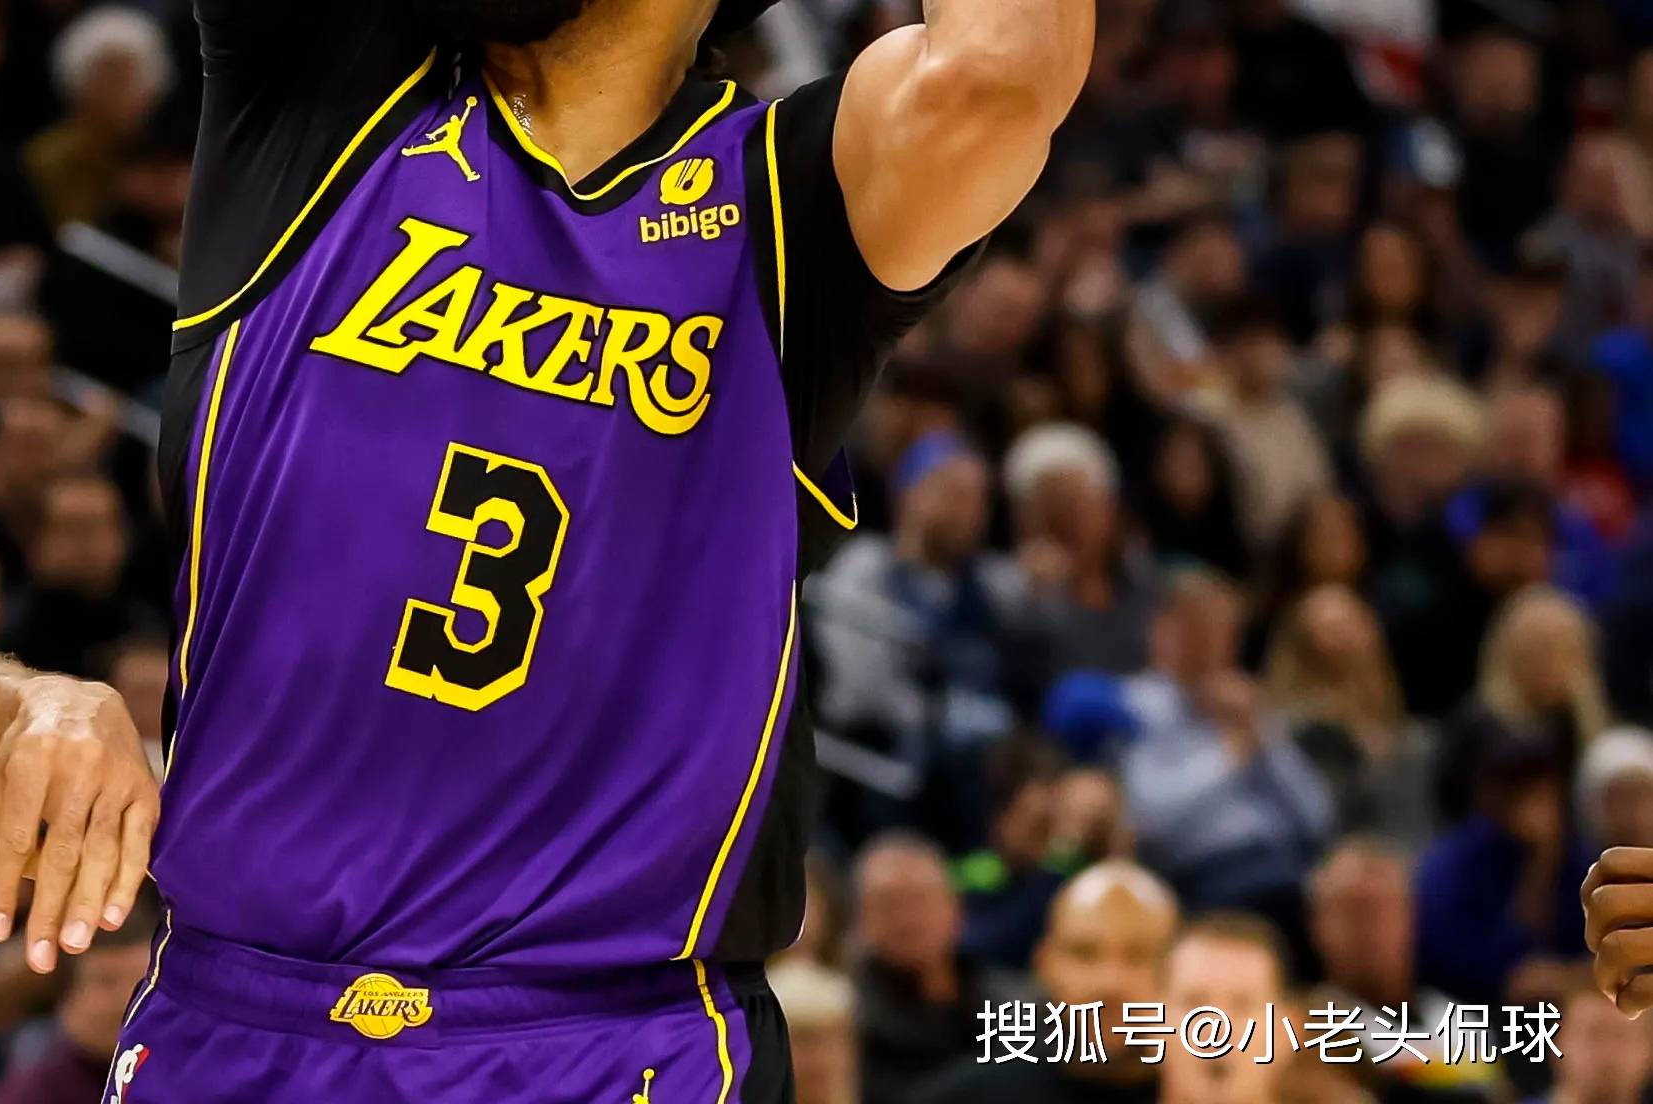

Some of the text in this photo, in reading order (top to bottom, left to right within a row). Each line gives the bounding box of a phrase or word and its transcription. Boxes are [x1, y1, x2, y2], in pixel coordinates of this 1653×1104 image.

[639, 203, 740, 243] bibigo
[308, 216, 724, 435] LAKERS
[384, 441, 570, 712] 3
[336, 990, 426, 1025] LAKERS
